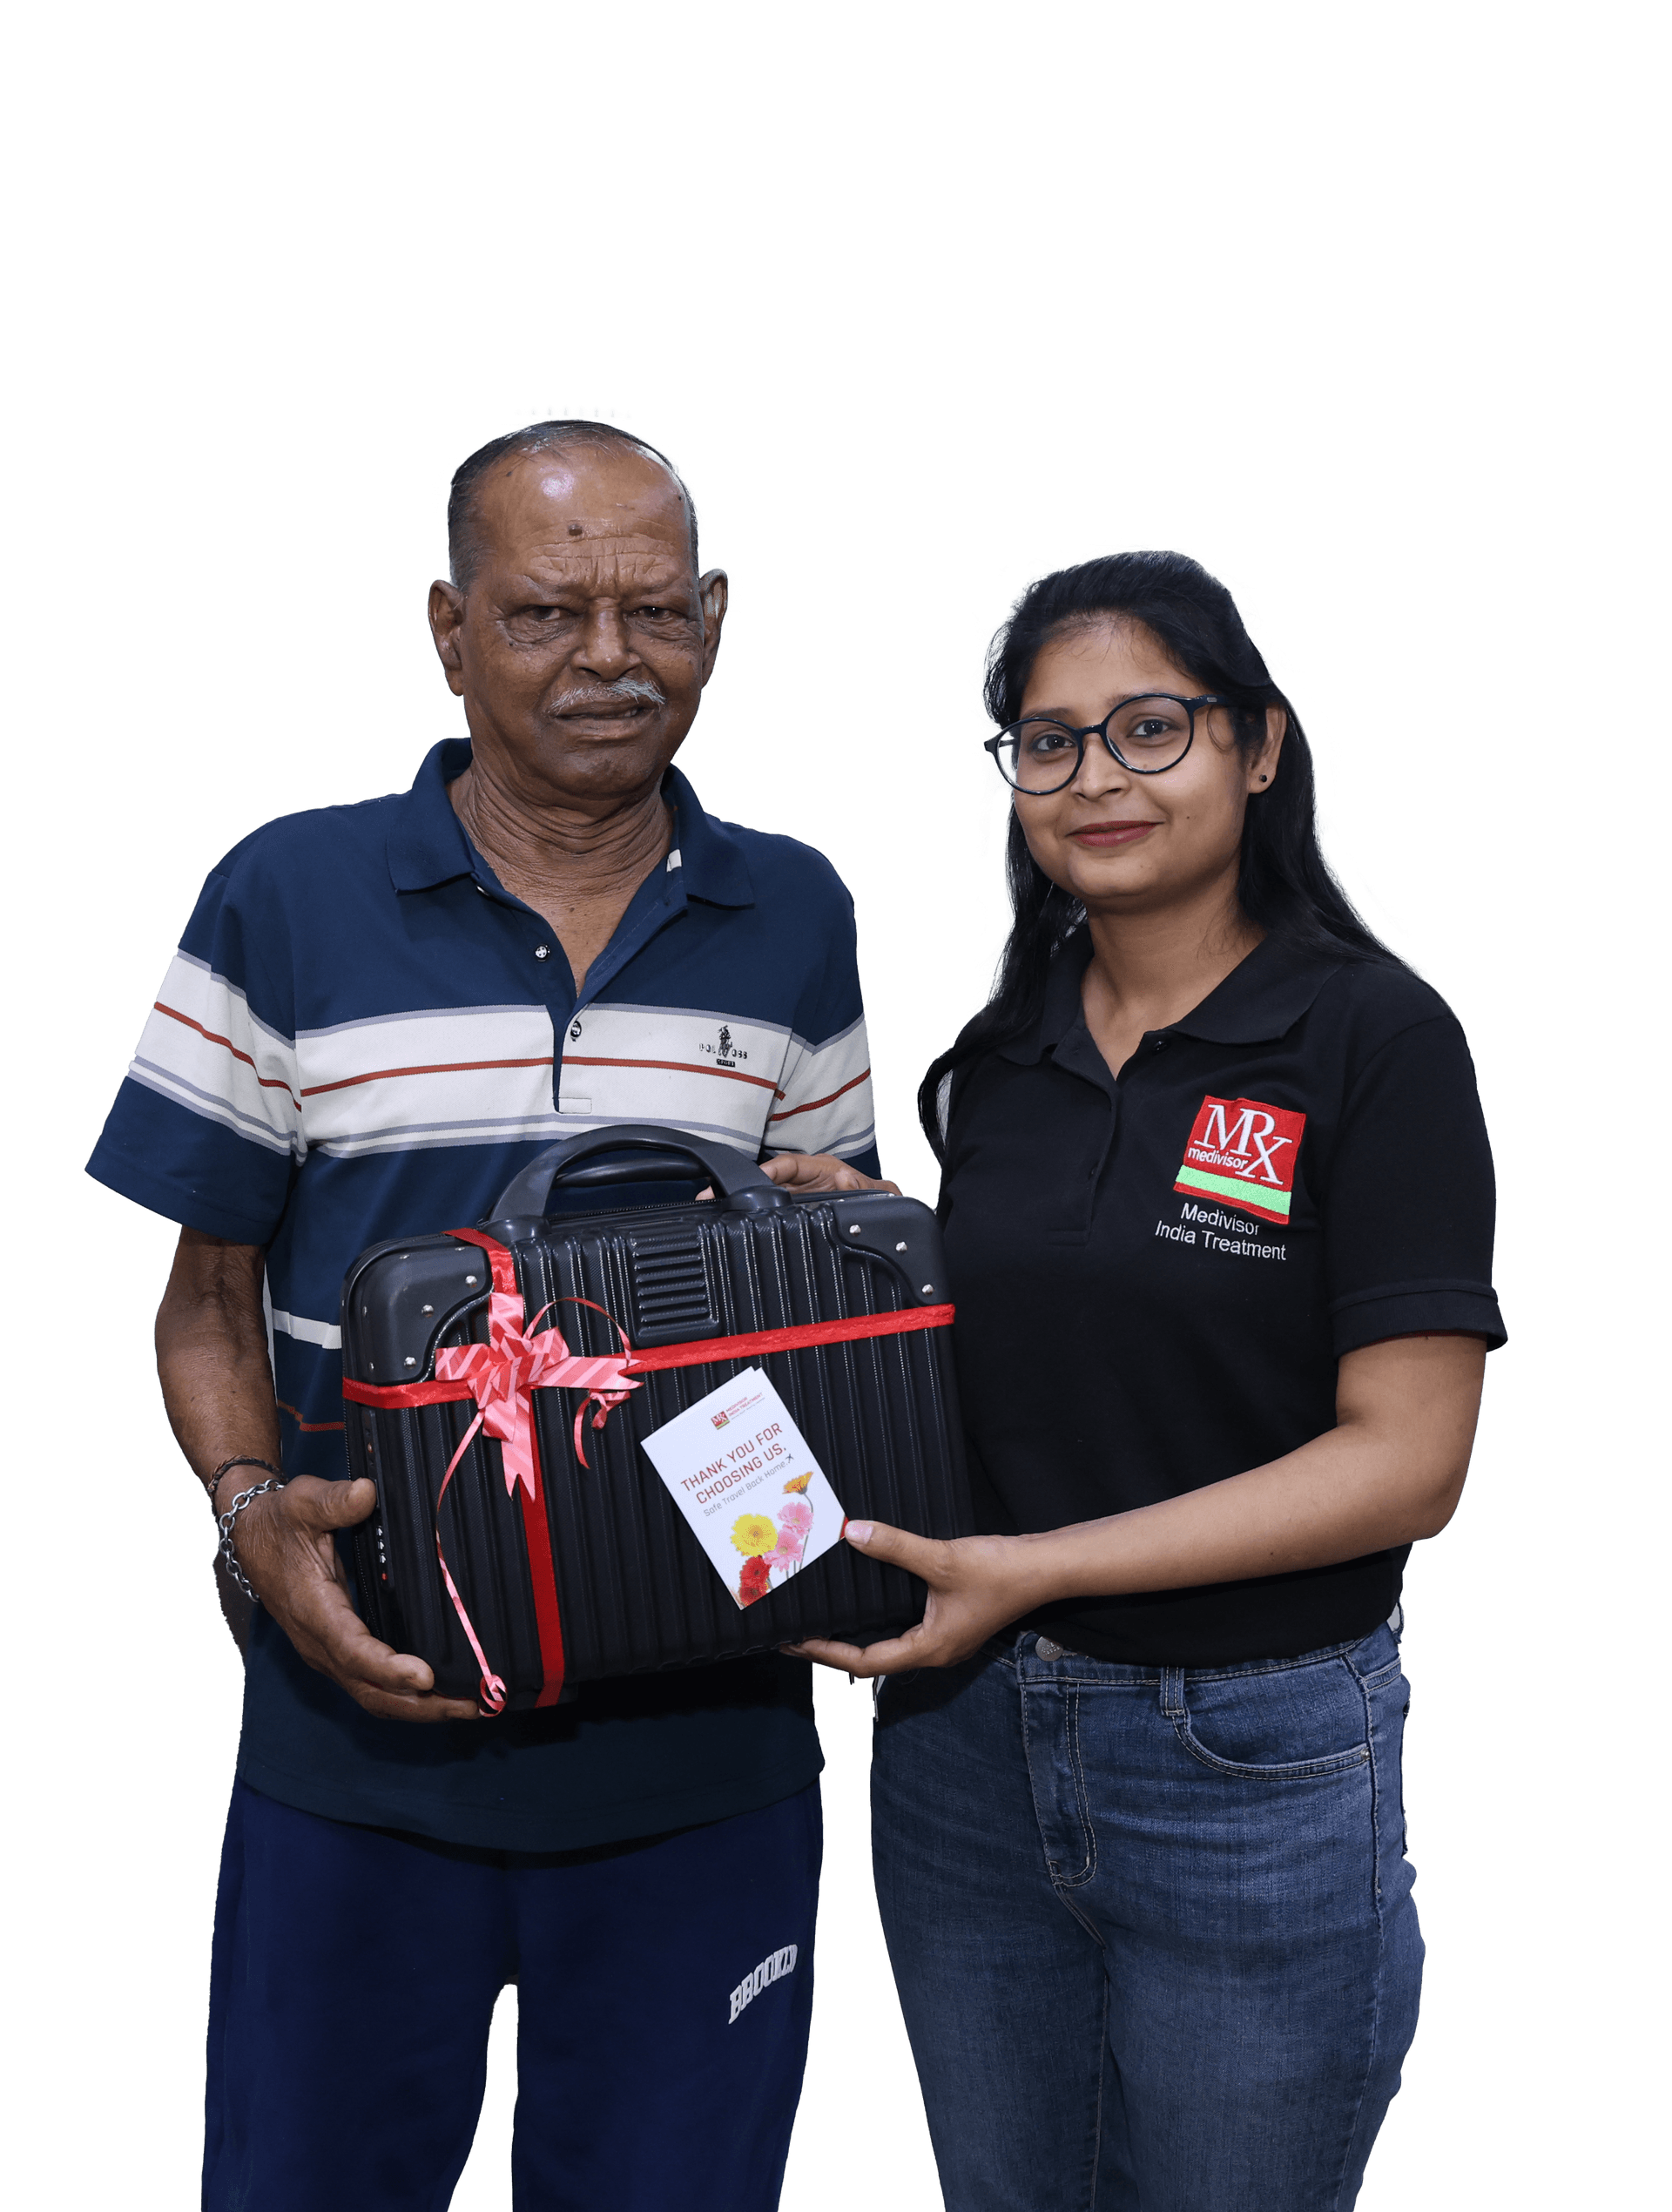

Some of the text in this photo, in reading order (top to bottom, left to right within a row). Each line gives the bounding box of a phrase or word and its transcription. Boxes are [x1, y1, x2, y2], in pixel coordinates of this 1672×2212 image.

[1188, 1147, 1248, 1170] medivisor
[1155, 1220, 1287, 1260] India Treatment
[1180, 1202, 1260, 1236] Medivisor
[680, 1422, 783, 1492] THANK YOU FOR
[696, 1442, 787, 1504] CHOOSING US.
[703, 1460, 789, 1517] Safe Travel Back Home.
